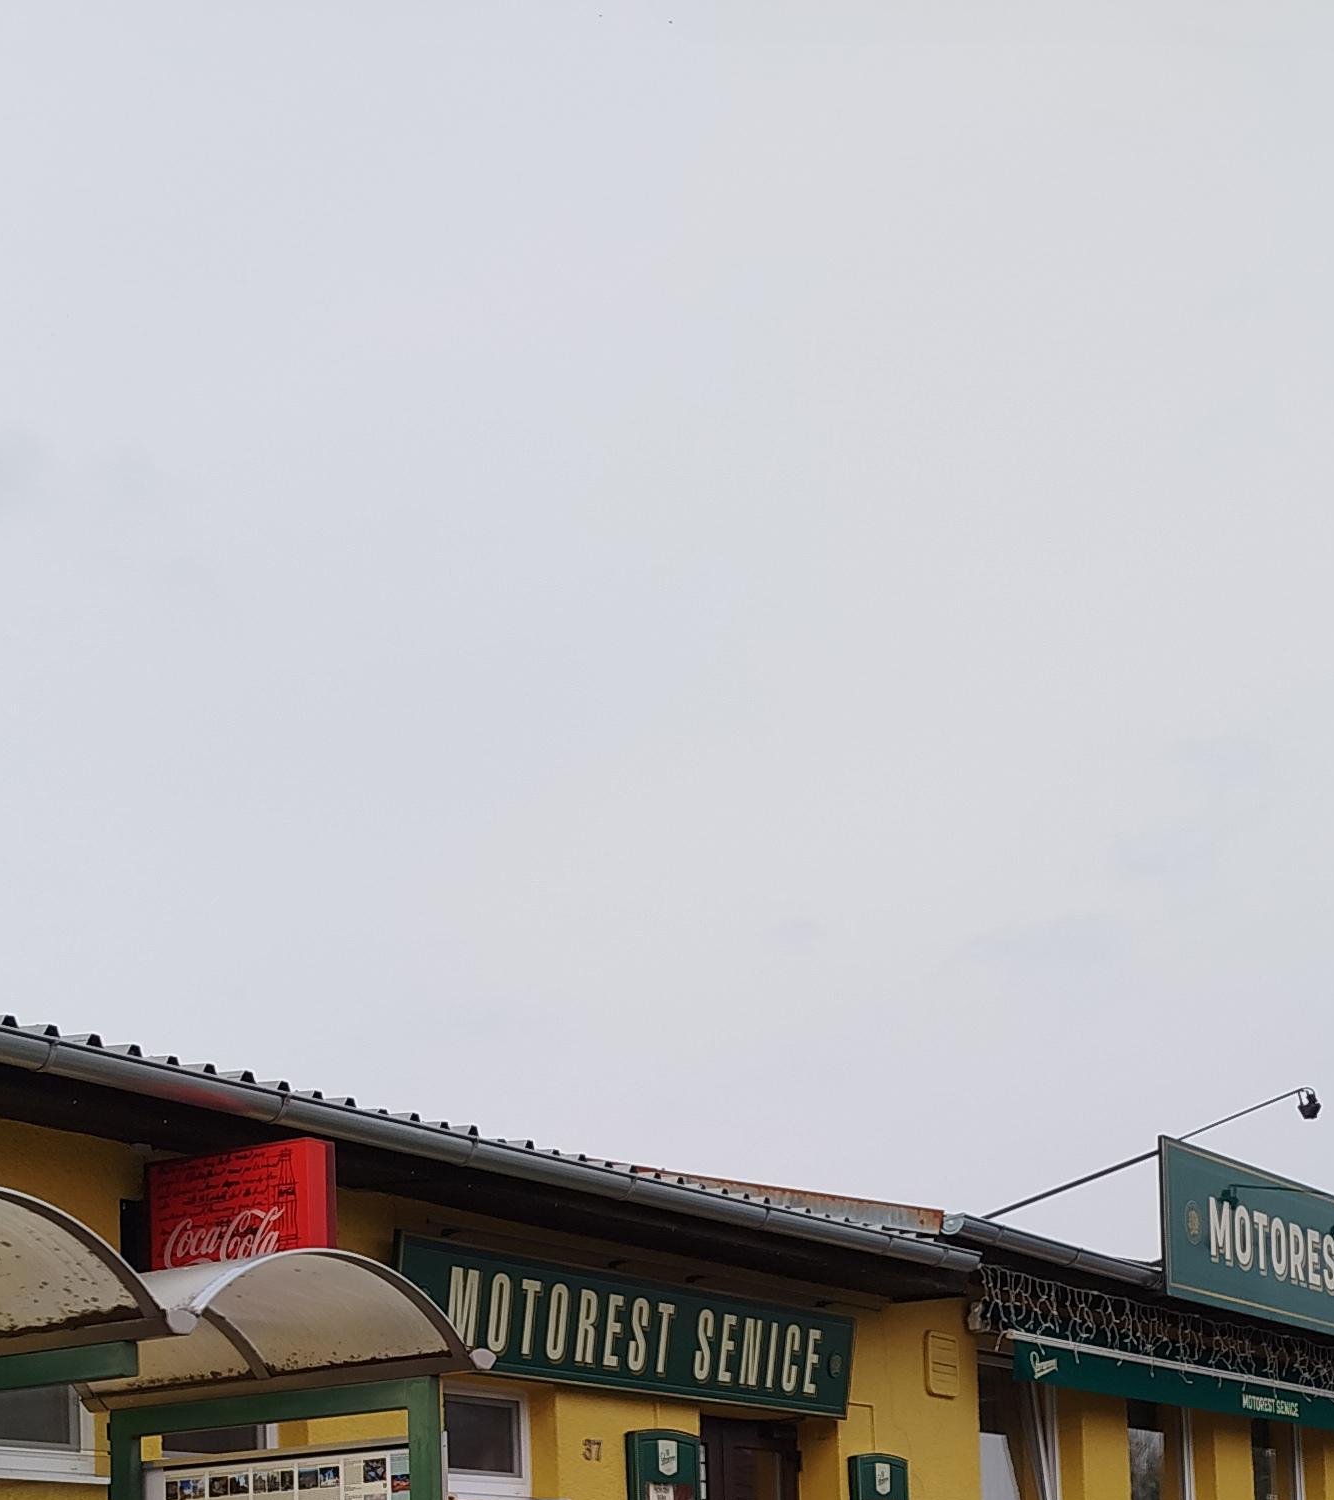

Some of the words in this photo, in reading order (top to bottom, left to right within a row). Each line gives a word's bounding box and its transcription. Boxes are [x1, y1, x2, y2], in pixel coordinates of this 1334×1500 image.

[448, 1265, 676, 1377] MOTOREST
[693, 1308, 824, 1397] SENICE
[1242, 1394, 1275, 1413] MOTOREST
[1276, 1400, 1299, 1417] SENICE
